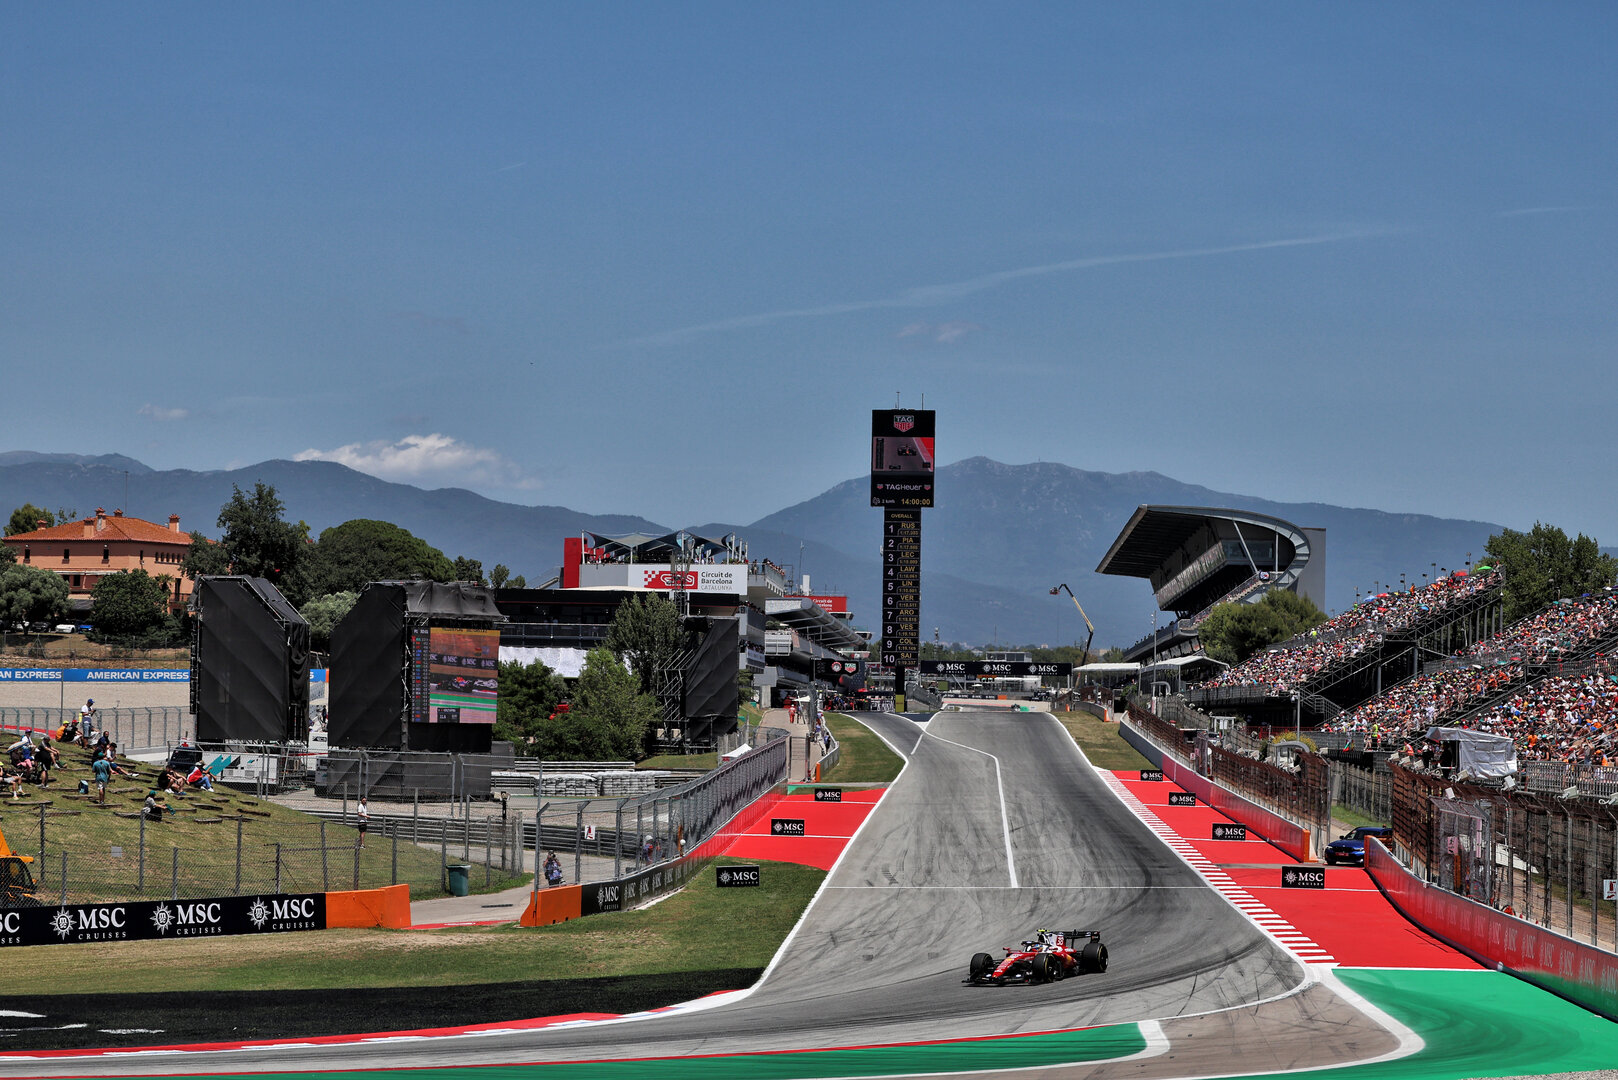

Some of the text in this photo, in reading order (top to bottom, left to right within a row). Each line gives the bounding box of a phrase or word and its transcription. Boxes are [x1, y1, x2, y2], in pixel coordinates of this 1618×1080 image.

[889, 525, 894, 533] 1
[888, 539, 894, 548] 2
[888, 568, 893, 576] 4
[888, 582, 893, 590] 5
[888, 597, 893, 605] 6
[887, 612, 892, 620] 7
[887, 640, 892, 648] 9
[884, 655, 894, 663] 10
[733, 872, 758, 880] MSC
[1298, 872, 1323, 881] MSC
[604, 886, 619, 902] MSC
[272, 898, 314, 919] MSC
[176, 903, 221, 925] MSC
[78, 908, 126, 930] MSC
[272, 922, 315, 930] CRUISES
[177, 927, 222, 935] CRUISES
[78, 932, 126, 940] CRUISES
